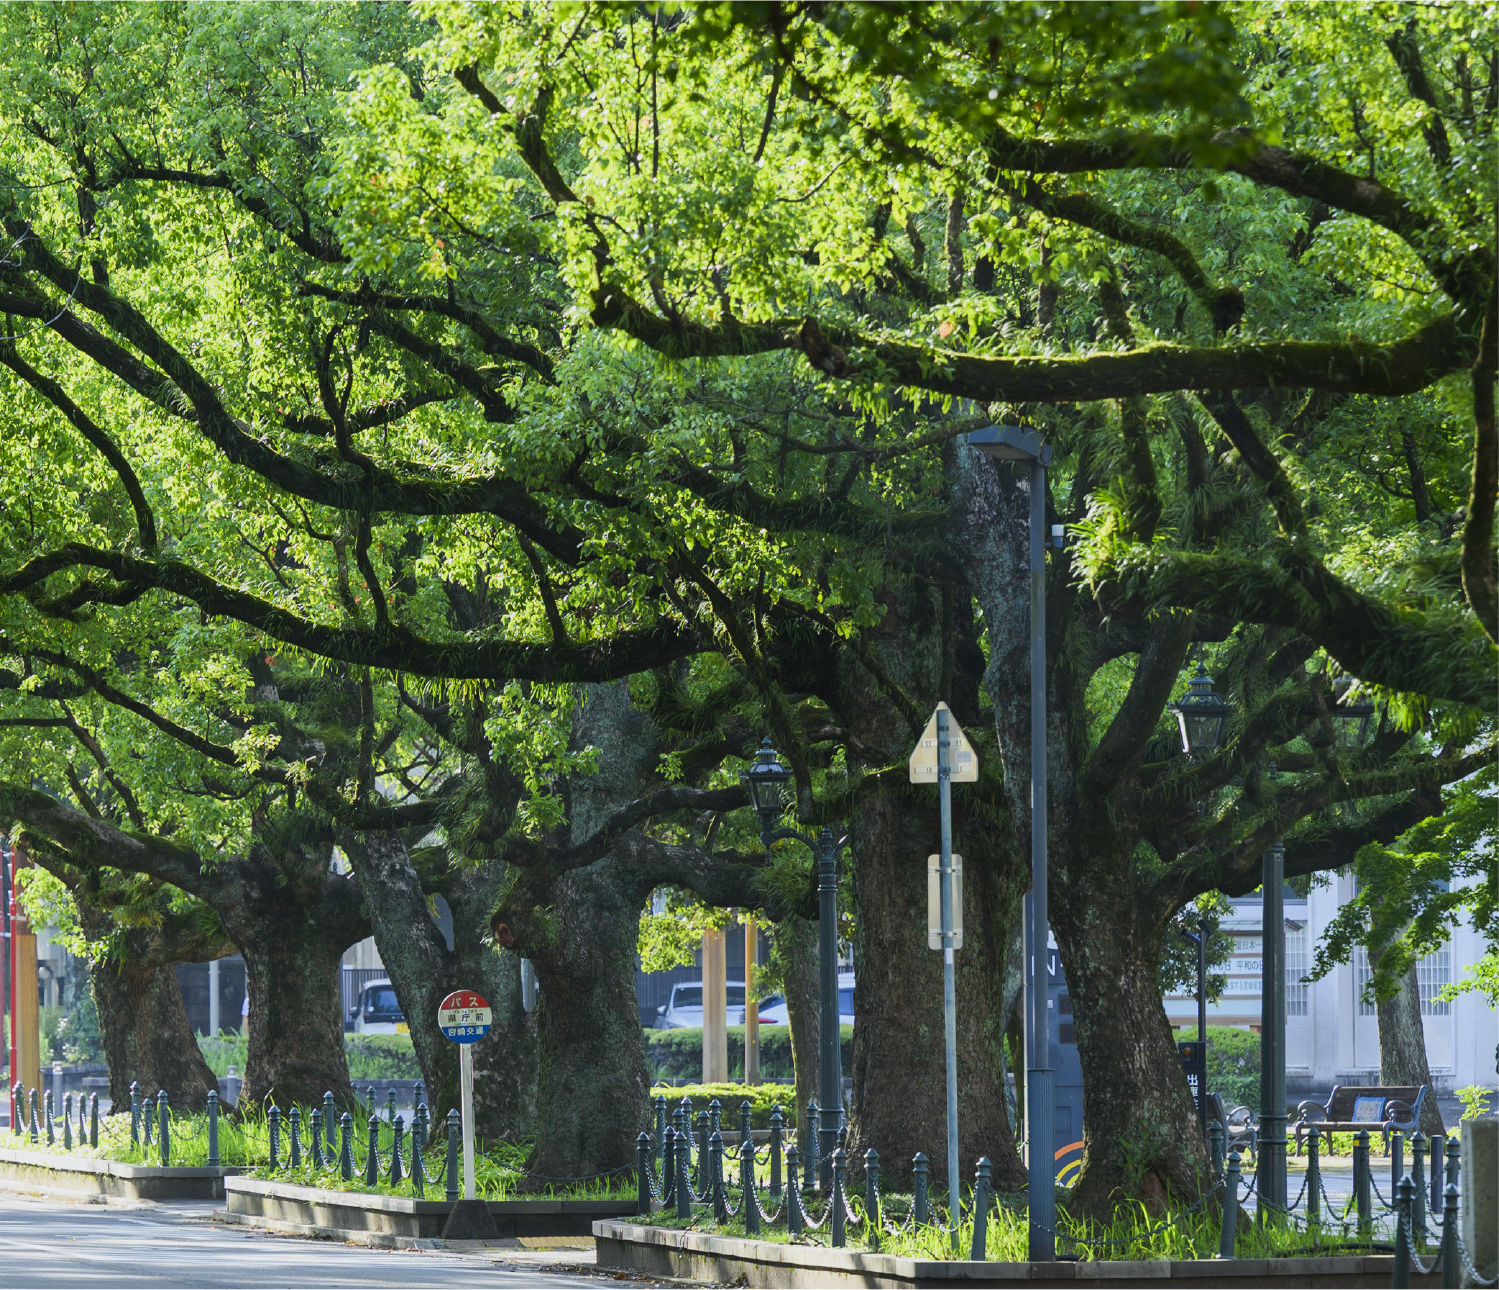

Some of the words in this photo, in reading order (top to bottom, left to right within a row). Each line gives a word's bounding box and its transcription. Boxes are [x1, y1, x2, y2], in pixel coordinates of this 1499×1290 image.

[451, 997, 478, 1007] バス
[448, 1013, 483, 1022] 県庁前
[448, 1026, 484, 1036] 宮崎交通
